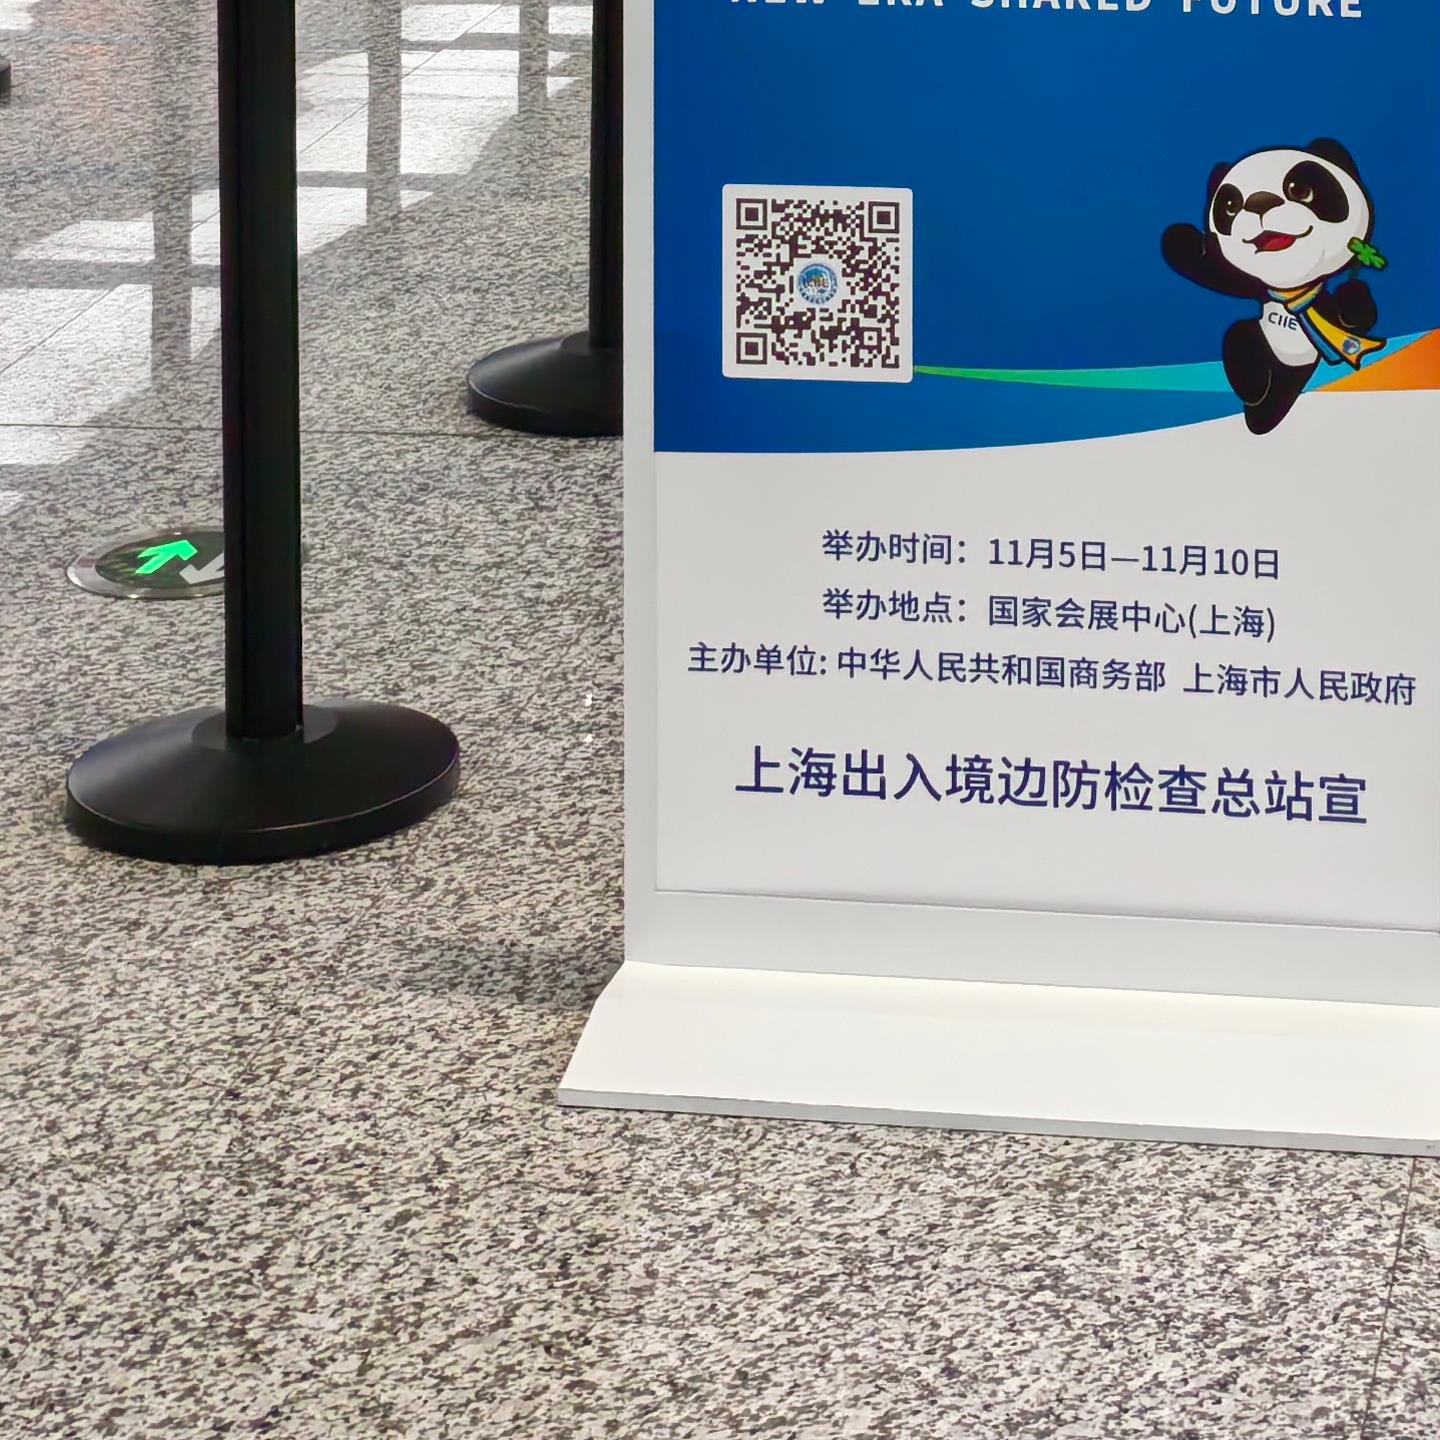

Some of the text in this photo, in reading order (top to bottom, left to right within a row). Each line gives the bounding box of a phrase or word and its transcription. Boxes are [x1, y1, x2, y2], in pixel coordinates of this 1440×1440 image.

[1183, 662, 1417, 707] 上海市人民政府
[735, 745, 1369, 825] 上海出入境边防检查总站宣
